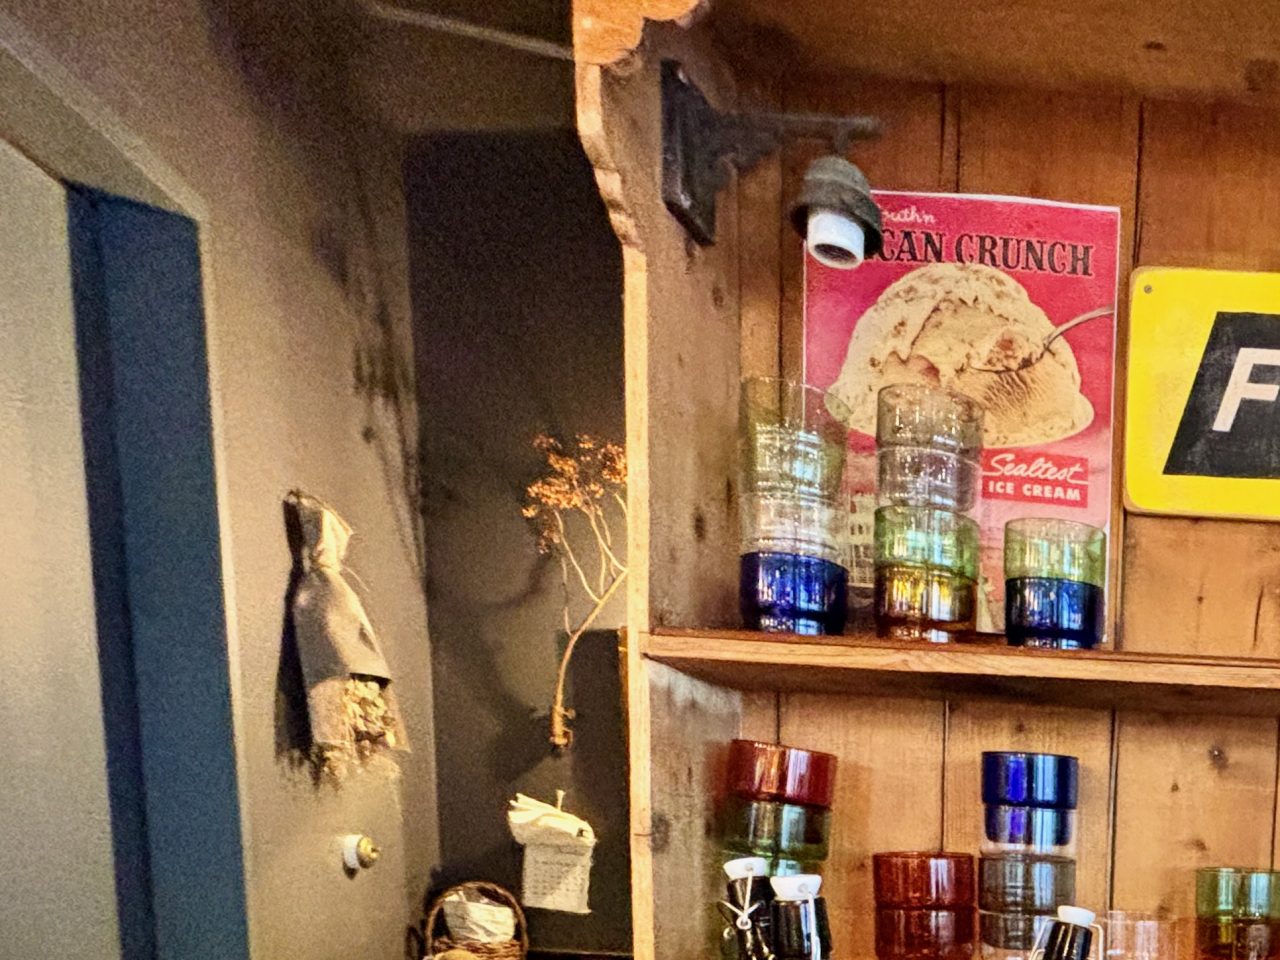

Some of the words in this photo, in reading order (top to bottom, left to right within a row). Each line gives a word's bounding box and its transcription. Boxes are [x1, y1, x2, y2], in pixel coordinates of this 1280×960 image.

[868, 228, 946, 264] CAN
[955, 233, 1094, 277] CRUNCH
[982, 452, 1089, 486] Sealtest
[988, 480, 1015, 495] ICE
[1022, 483, 1081, 502] CREAM
